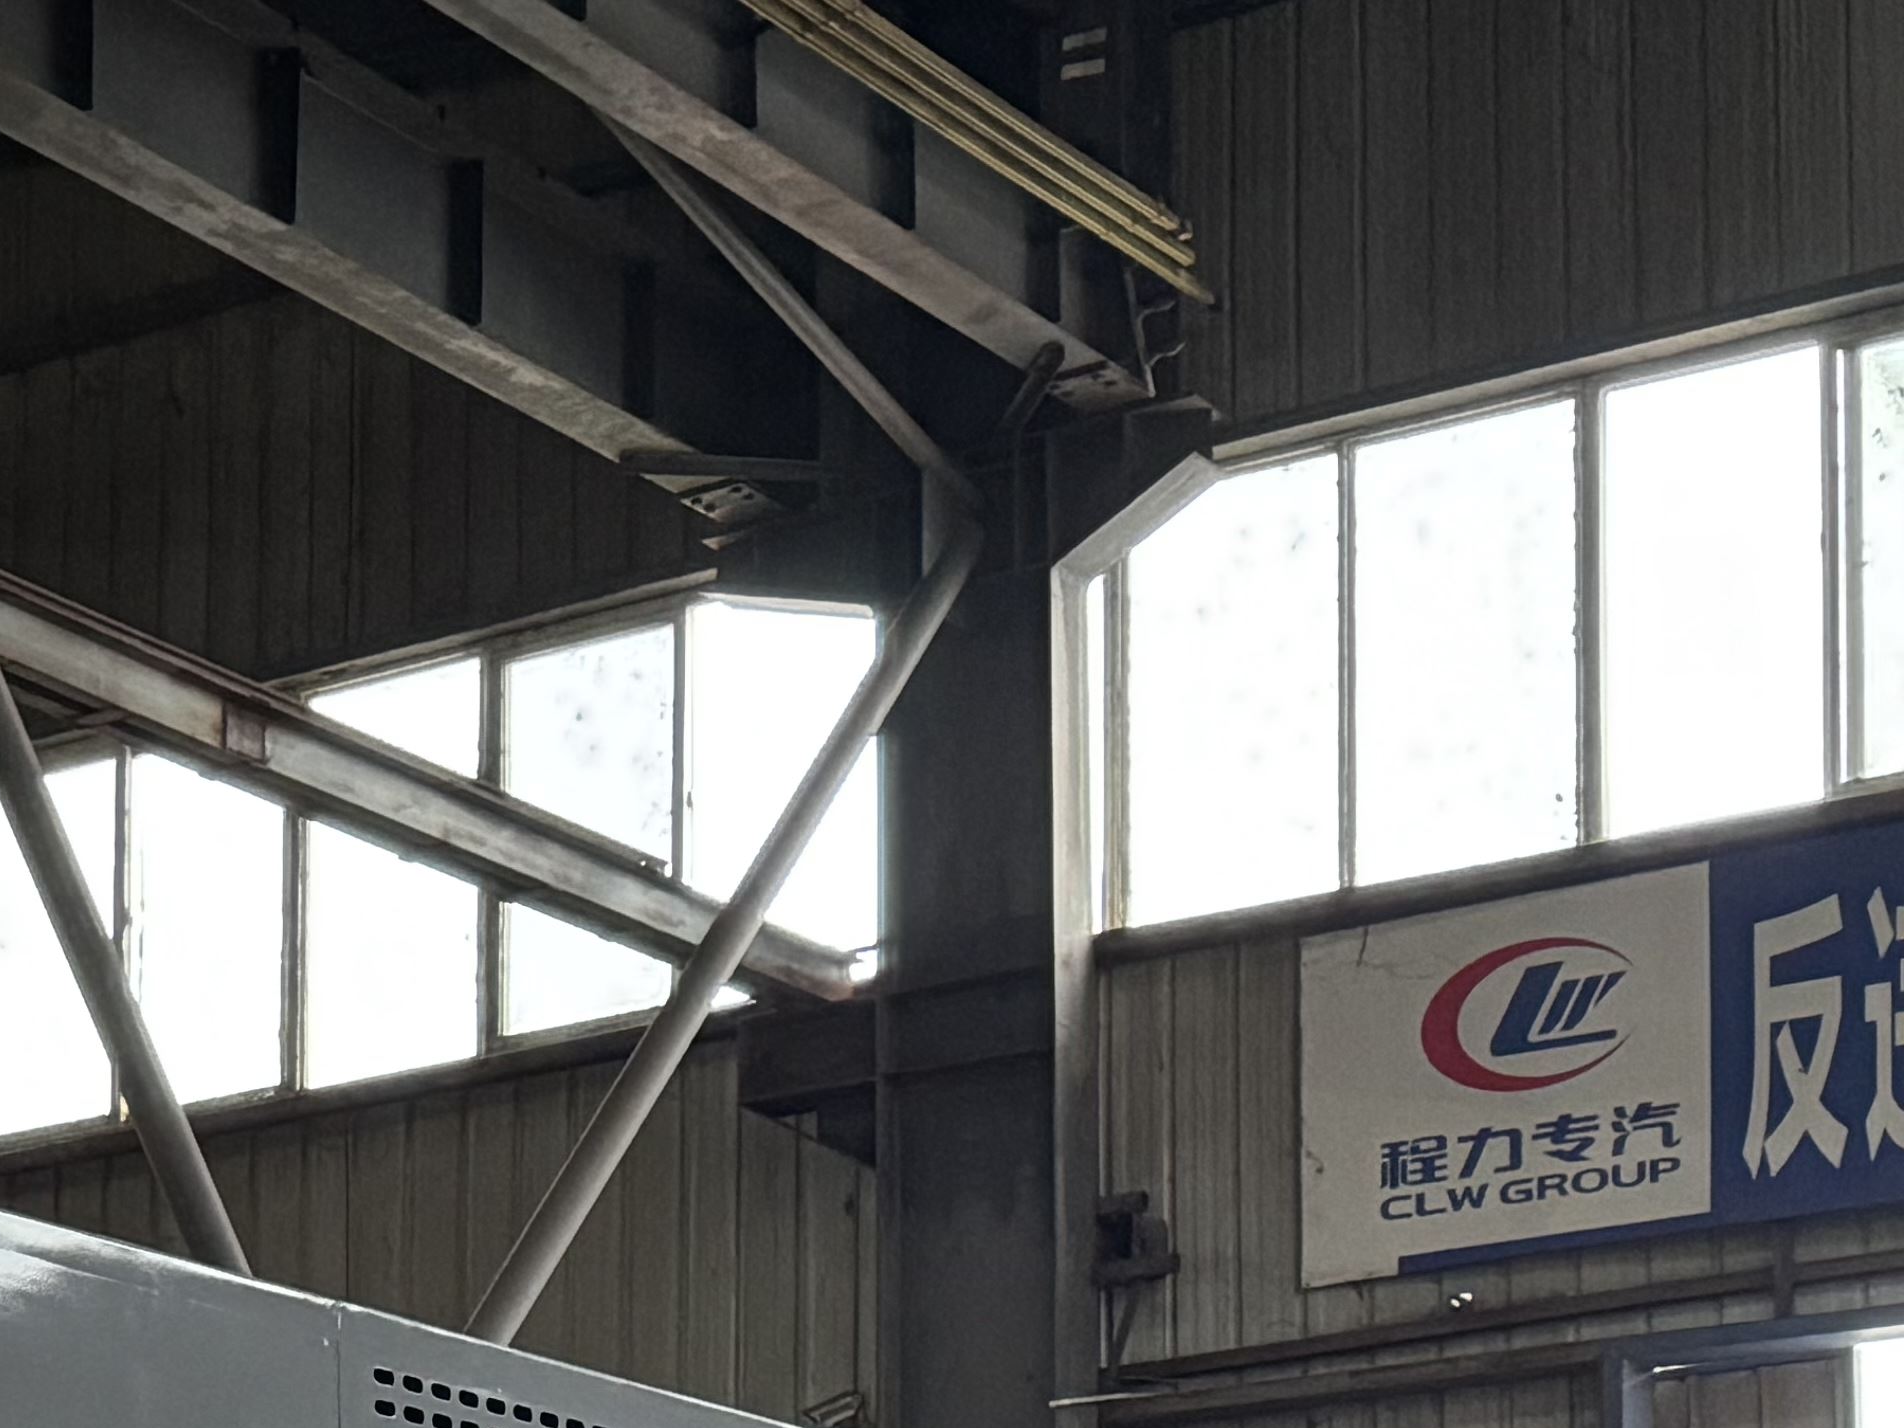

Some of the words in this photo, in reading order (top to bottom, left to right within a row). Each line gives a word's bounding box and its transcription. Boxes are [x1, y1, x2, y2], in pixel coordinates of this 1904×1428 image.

[1379, 1101, 1682, 1190] 程力专汽
[1379, 1183, 1489, 1221] CLW
[1498, 1156, 1682, 1206] GROUP
